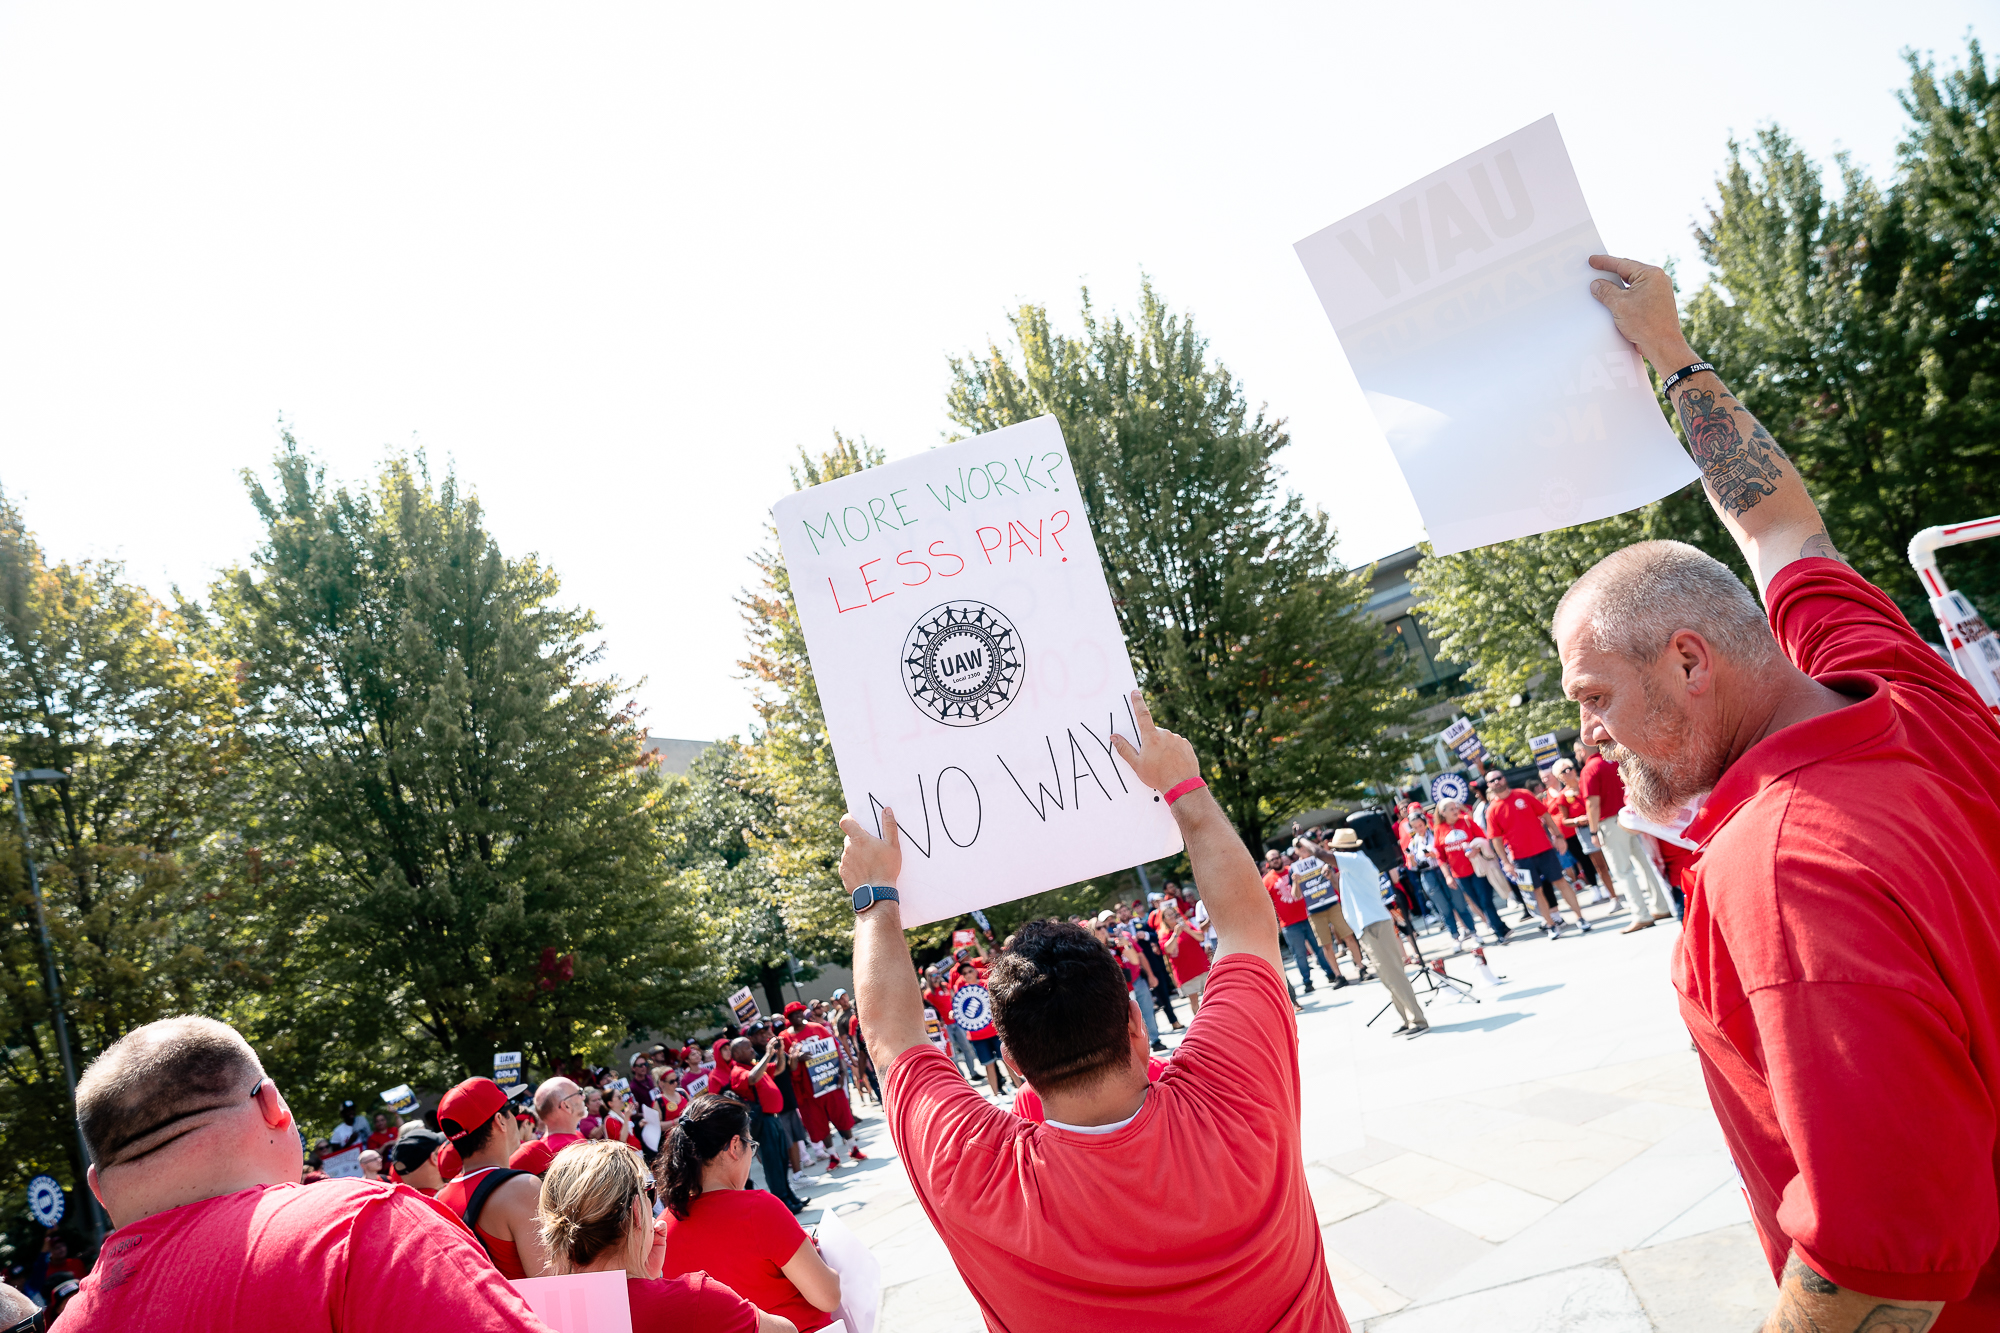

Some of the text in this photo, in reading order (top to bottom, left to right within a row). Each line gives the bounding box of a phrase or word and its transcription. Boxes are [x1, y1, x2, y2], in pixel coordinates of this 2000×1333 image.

[803, 452, 1063, 555] MORE WORK?
[828, 510, 1070, 614] LESS PAY?
[940, 648, 982, 677] UAW
[953, 671, 981, 683] Local 2300
[1446, 722, 1465, 739] UAW
[1534, 737, 1549, 747] UAW
[868, 766, 982, 858] NO
[1297, 859, 1317, 873] UAW
[808, 1040, 829, 1056] UAW
[500, 1055, 517, 1063] UAW
[495, 1069, 518, 1079] COLA
[814, 1061, 834, 1073] COLA
[692, 1079, 706, 1092] UAW
